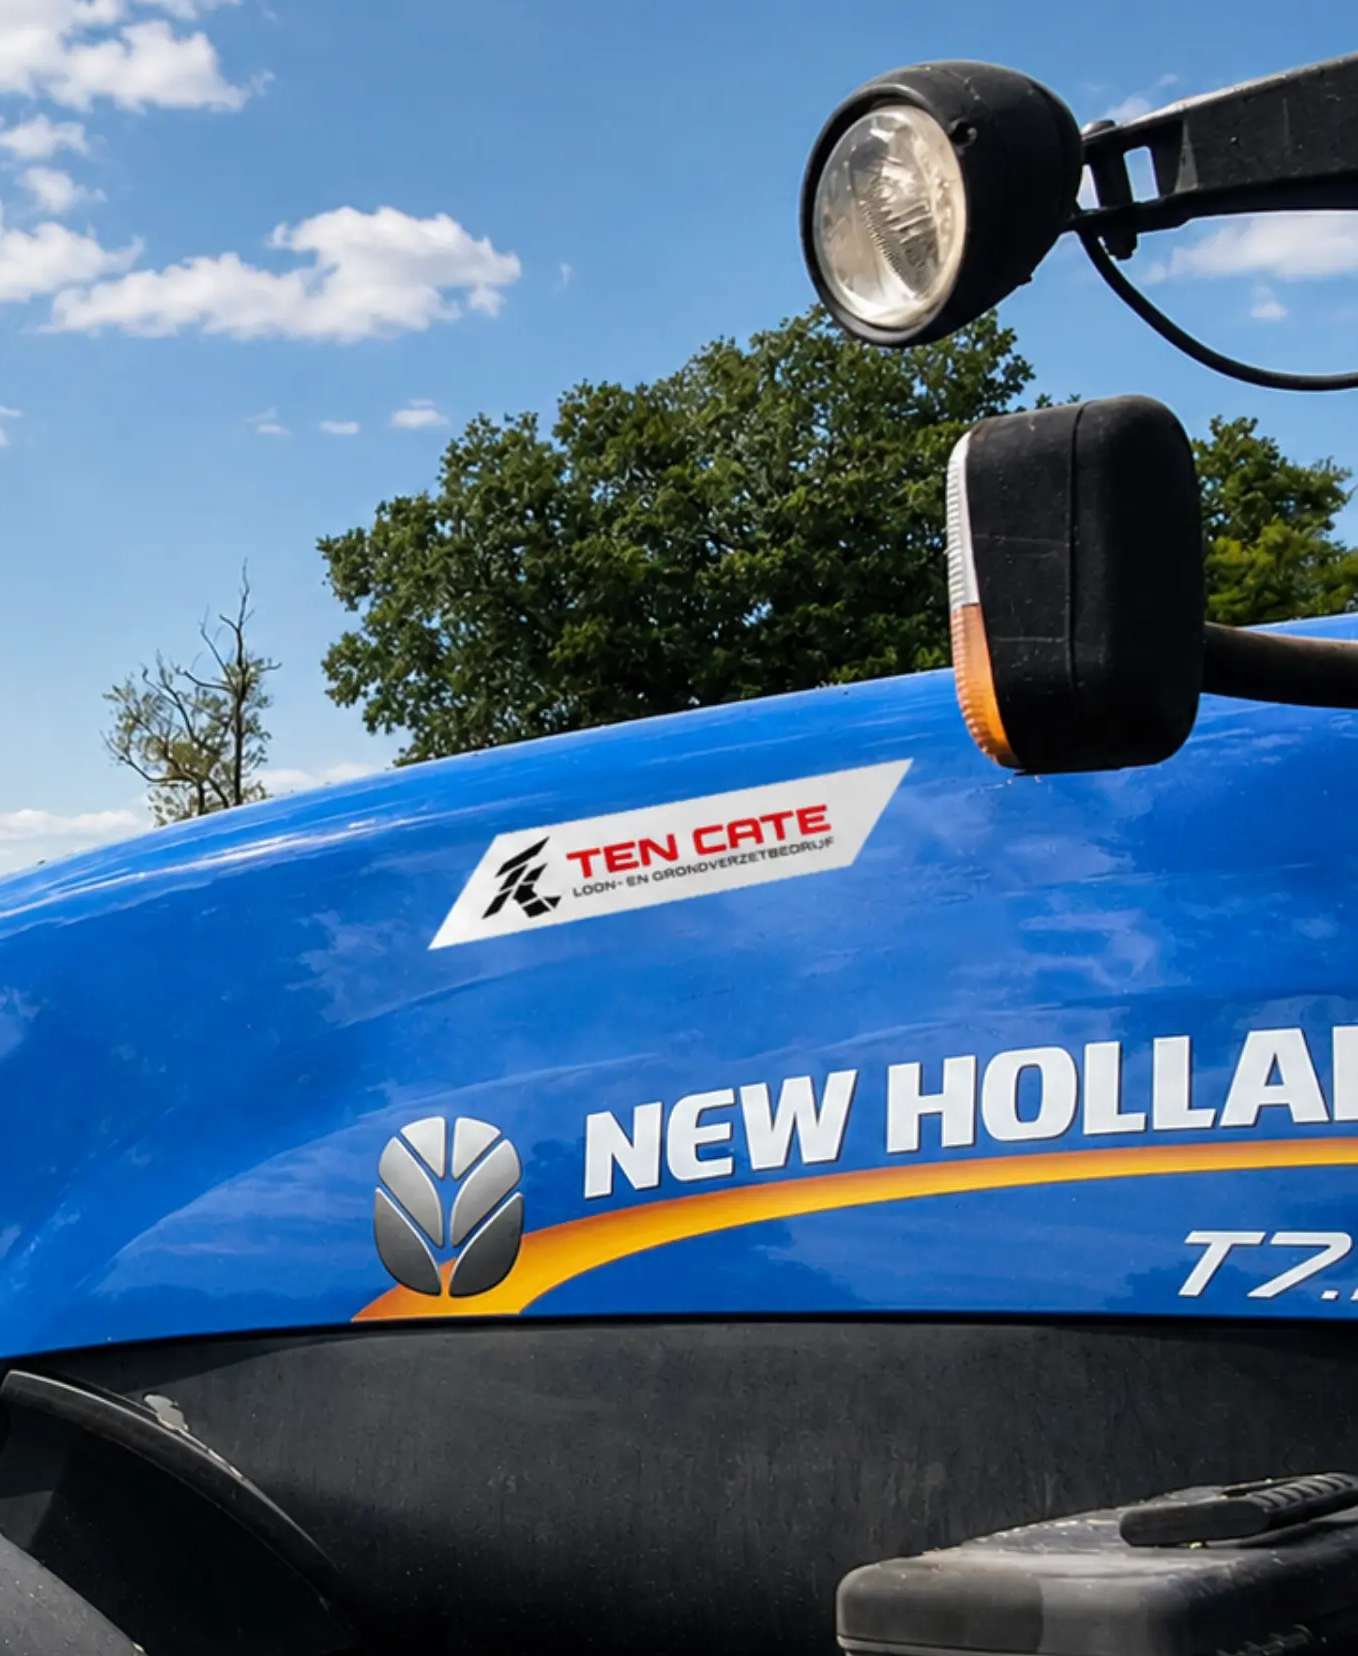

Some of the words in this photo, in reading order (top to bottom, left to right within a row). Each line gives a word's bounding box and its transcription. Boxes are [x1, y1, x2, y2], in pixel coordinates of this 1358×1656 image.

[566, 833, 679, 879] TEN
[692, 804, 832, 856] CATE
[572, 880, 623, 898] LOON-
[626, 874, 649, 887] EN
[652, 836, 834, 882] GRONDVERZETBEDRIJF
[583, 1069, 858, 1199] NEW
[1178, 1230, 1358, 1301] T7.
